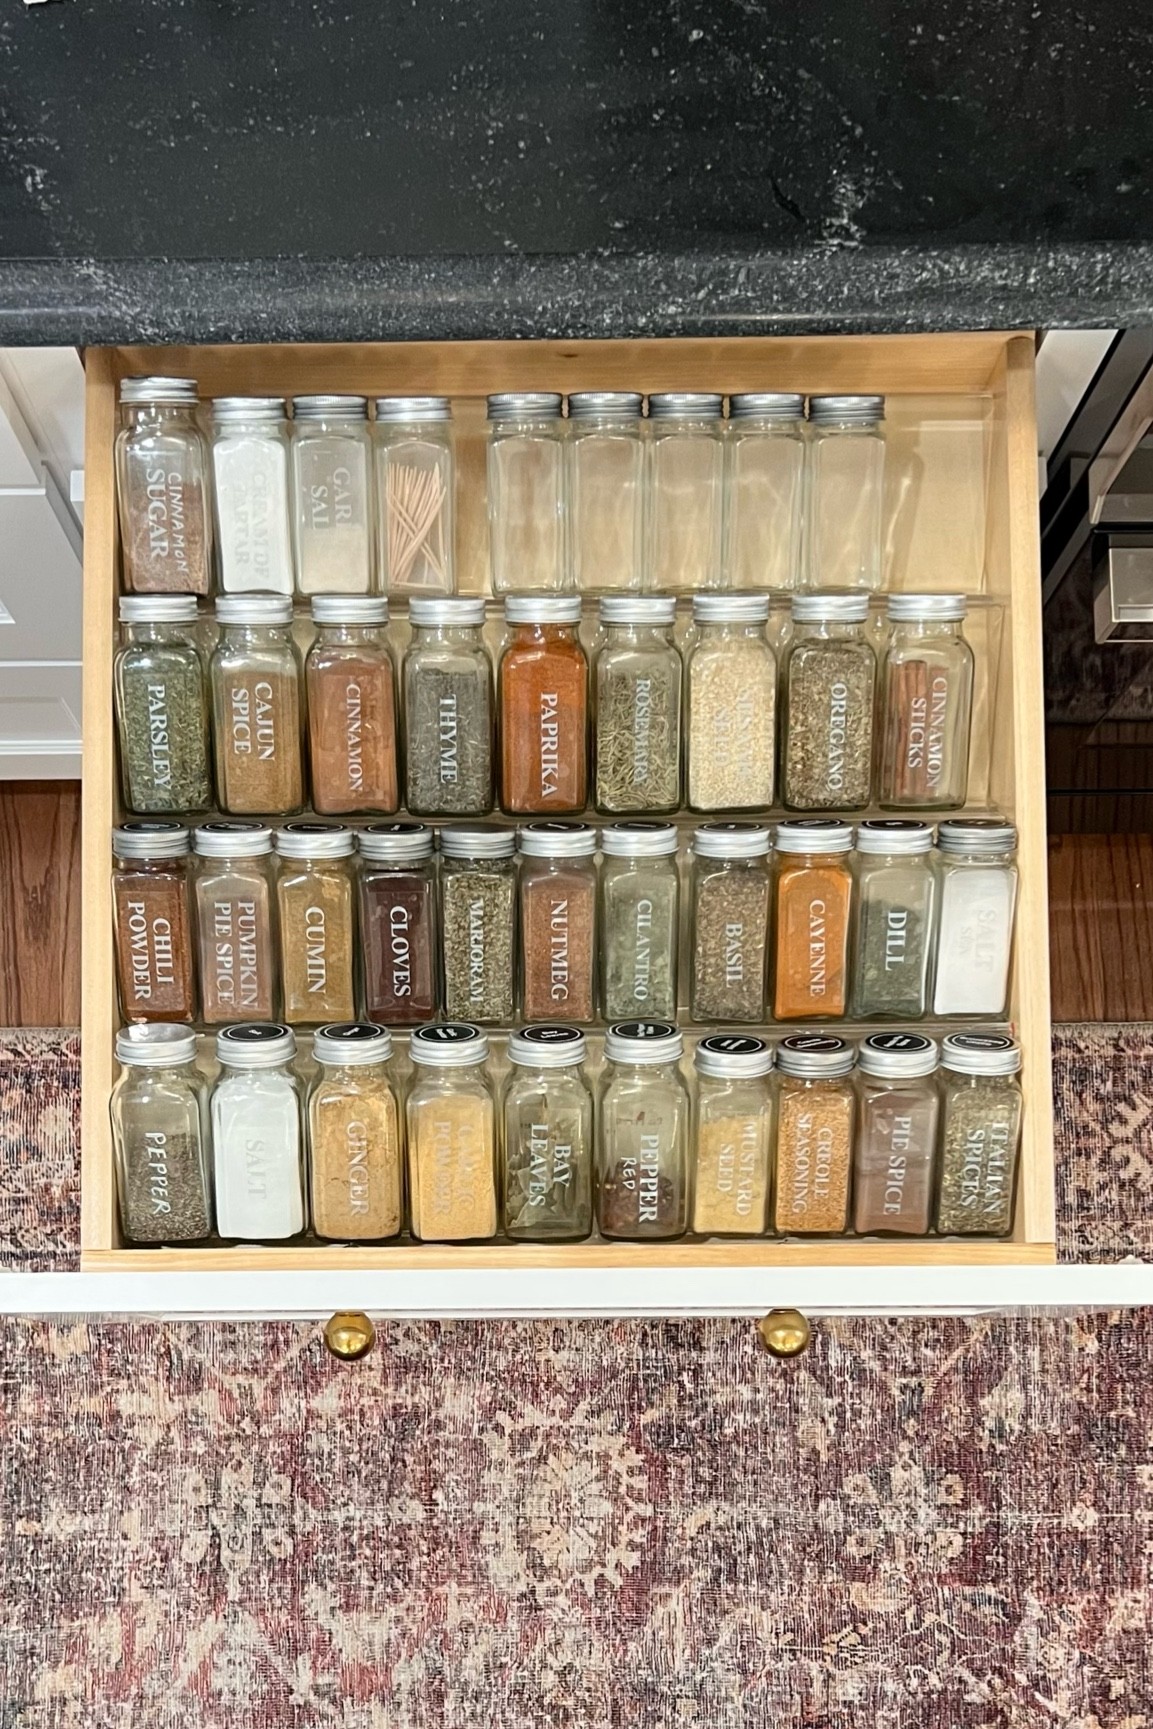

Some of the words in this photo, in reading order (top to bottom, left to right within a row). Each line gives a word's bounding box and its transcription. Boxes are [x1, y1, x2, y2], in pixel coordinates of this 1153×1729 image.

[146, 468, 169, 558] SUGAR
[147, 683, 172, 790] PARSLEY
[231, 688, 251, 754] SPICE
[254, 681, 275, 761] CAJUN
[346, 683, 363, 792] CINNAMON
[439, 693, 458, 784] THYME
[540, 692, 558, 798] PAPRIKA
[634, 679, 651, 785] ROSEMARY
[827, 682, 848, 790] OREGANO
[908, 697, 927, 769] STICKS
[926, 677, 948, 787] CINNAMON
[127, 900, 152, 1000] POWDER
[152, 917, 175, 984] CHILI
[214, 901, 233, 938] PIE
[237, 900, 259, 1008] PUMPKIN
[305, 906, 327, 994] CUMIN
[389, 905, 412, 997] CLOVES
[469, 899, 484, 1002] MARJORAM
[550, 899, 569, 1001] NUTMEG
[633, 899, 653, 1000] CILANTRO
[725, 922, 743, 989] BASIL
[809, 899, 826, 997] CAYENNE
[885, 910, 907, 972] DILL
[974, 909, 998, 973] SALT
[215, 942, 235, 1005] SPICE
[145, 1131, 171, 1215] PEPPER
[245, 1137, 267, 1200] SALT
[346, 1120, 370, 1217] GINGER
[529, 1122, 549, 1207] LEAVES
[554, 1144, 572, 1187] BAY
[717, 1143, 735, 1193] SEED
[736, 1120, 758, 1216] MUSTARD
[792, 1112, 813, 1214] SEASONING
[814, 1127, 834, 1200] CREOLE
[891, 1116, 912, 1151] PIE
[960, 1129, 986, 1207] SPICES
[983, 1122, 1009, 1213] ITALIAN
[638, 1134, 659, 1223] PEPPER
[883, 1155, 907, 1216] SPICE
